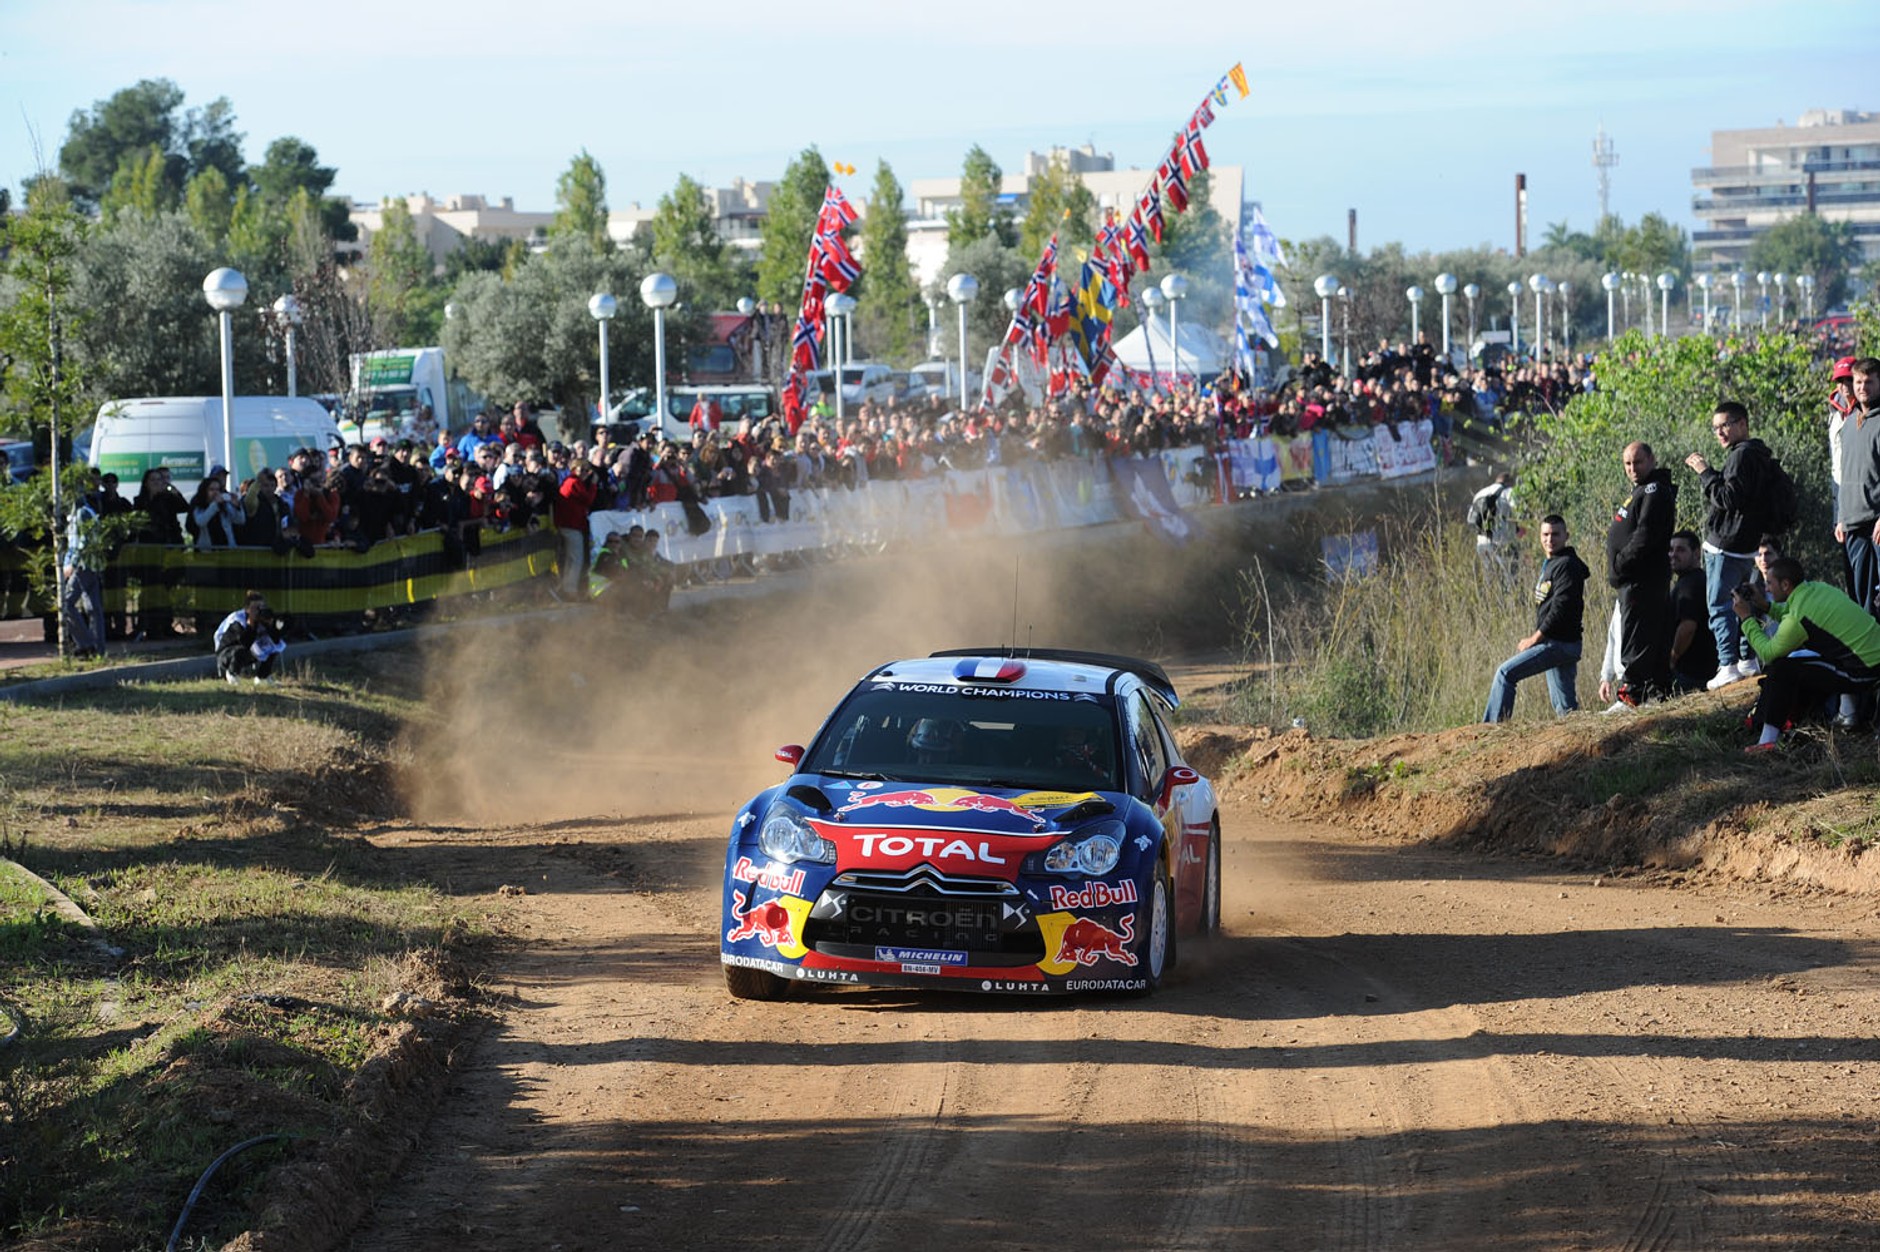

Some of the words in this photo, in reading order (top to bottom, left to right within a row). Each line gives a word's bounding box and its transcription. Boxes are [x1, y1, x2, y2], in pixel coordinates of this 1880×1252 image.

[899, 683, 958, 695] WORLD
[961, 686, 1071, 701] CHAMPIONS
[852, 833, 1006, 864] TOTAL
[898, 951, 964, 962] MICHELIN
[807, 971, 859, 982] LUHTA
[995, 982, 1050, 991] LUHTA
[1066, 979, 1147, 991] EURODATACAR
